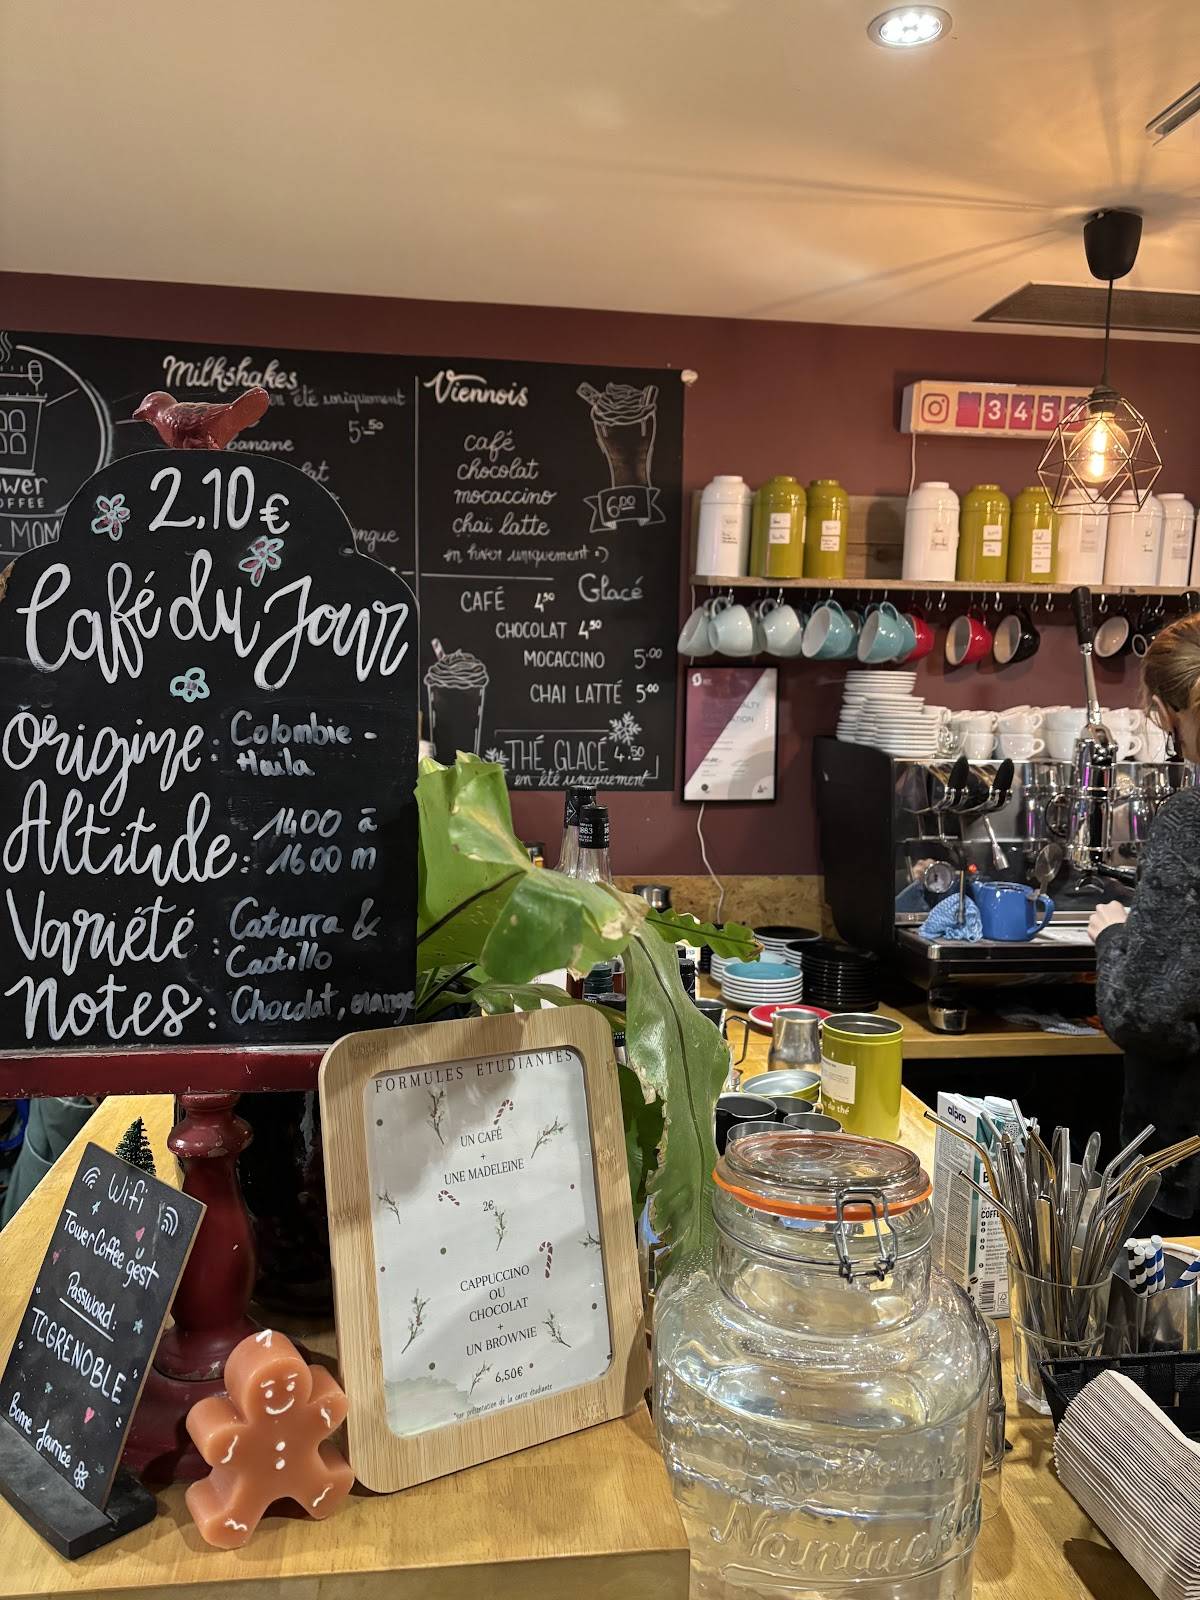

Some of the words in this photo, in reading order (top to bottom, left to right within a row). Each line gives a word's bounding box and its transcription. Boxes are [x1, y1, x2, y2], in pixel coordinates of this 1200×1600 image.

[162, 355, 298, 392] Milkshakes
[322, 389, 406, 413] uniquement
[423, 370, 528, 407] Viennois
[464, 429, 516, 461] café
[457, 457, 539, 481] chocolat
[0, 477, 49, 496] wer
[454, 488, 557, 506] mocaccino
[498, 511, 551, 537] latte
[506, 544, 590, 569] uniquement
[460, 586, 505, 612] CAFÉ
[578, 573, 644, 602] Glacé
[17, 562, 161, 684] Café
[169, 549, 260, 658] du
[253, 575, 409, 690] Jour
[495, 621, 568, 639] CHOCOLAT
[524, 650, 606, 669] MOCACCINO
[530, 684, 567, 704] CHAI
[575, 680, 622, 704] LATTÉ
[230, 709, 352, 746] Colombie
[504, 735, 545, 771] THÉ
[553, 737, 609, 771] GLACÉ
[514, 775, 533, 786] en
[538, 769, 560, 786] été
[562, 769, 652, 786] uniquement
[252, 807, 343, 841] 1400
[265, 842, 343, 876] 1600
[350, 846, 377, 870] m
[229, 896, 345, 940] Caturra
[351, 897, 382, 941] &
[374, 1066, 464, 1093] FORMULES
[476, 1049, 574, 1077] ETUDIANTES
[947, 1104, 967, 1124] alpro
[460, 1133, 476, 1147] UN
[478, 1126, 503, 1144] CAFÉ
[444, 1171, 467, 1185] UNE
[468, 1158, 525, 1181] MADELEINE
[107, 1173, 149, 1214] Wifi
[482, 1200, 494, 1212] 2€
[460, 1264, 531, 1292] CAPPUCCINO
[489, 1287, 506, 1300] OU
[469, 1297, 529, 1322] CHOCOLAT
[466, 1342, 483, 1357] UN
[485, 1326, 538, 1351] BROWNIE
[32, 1306, 127, 1404] TCGRENOBLE
[494, 1366, 524, 1384] 6,50€
